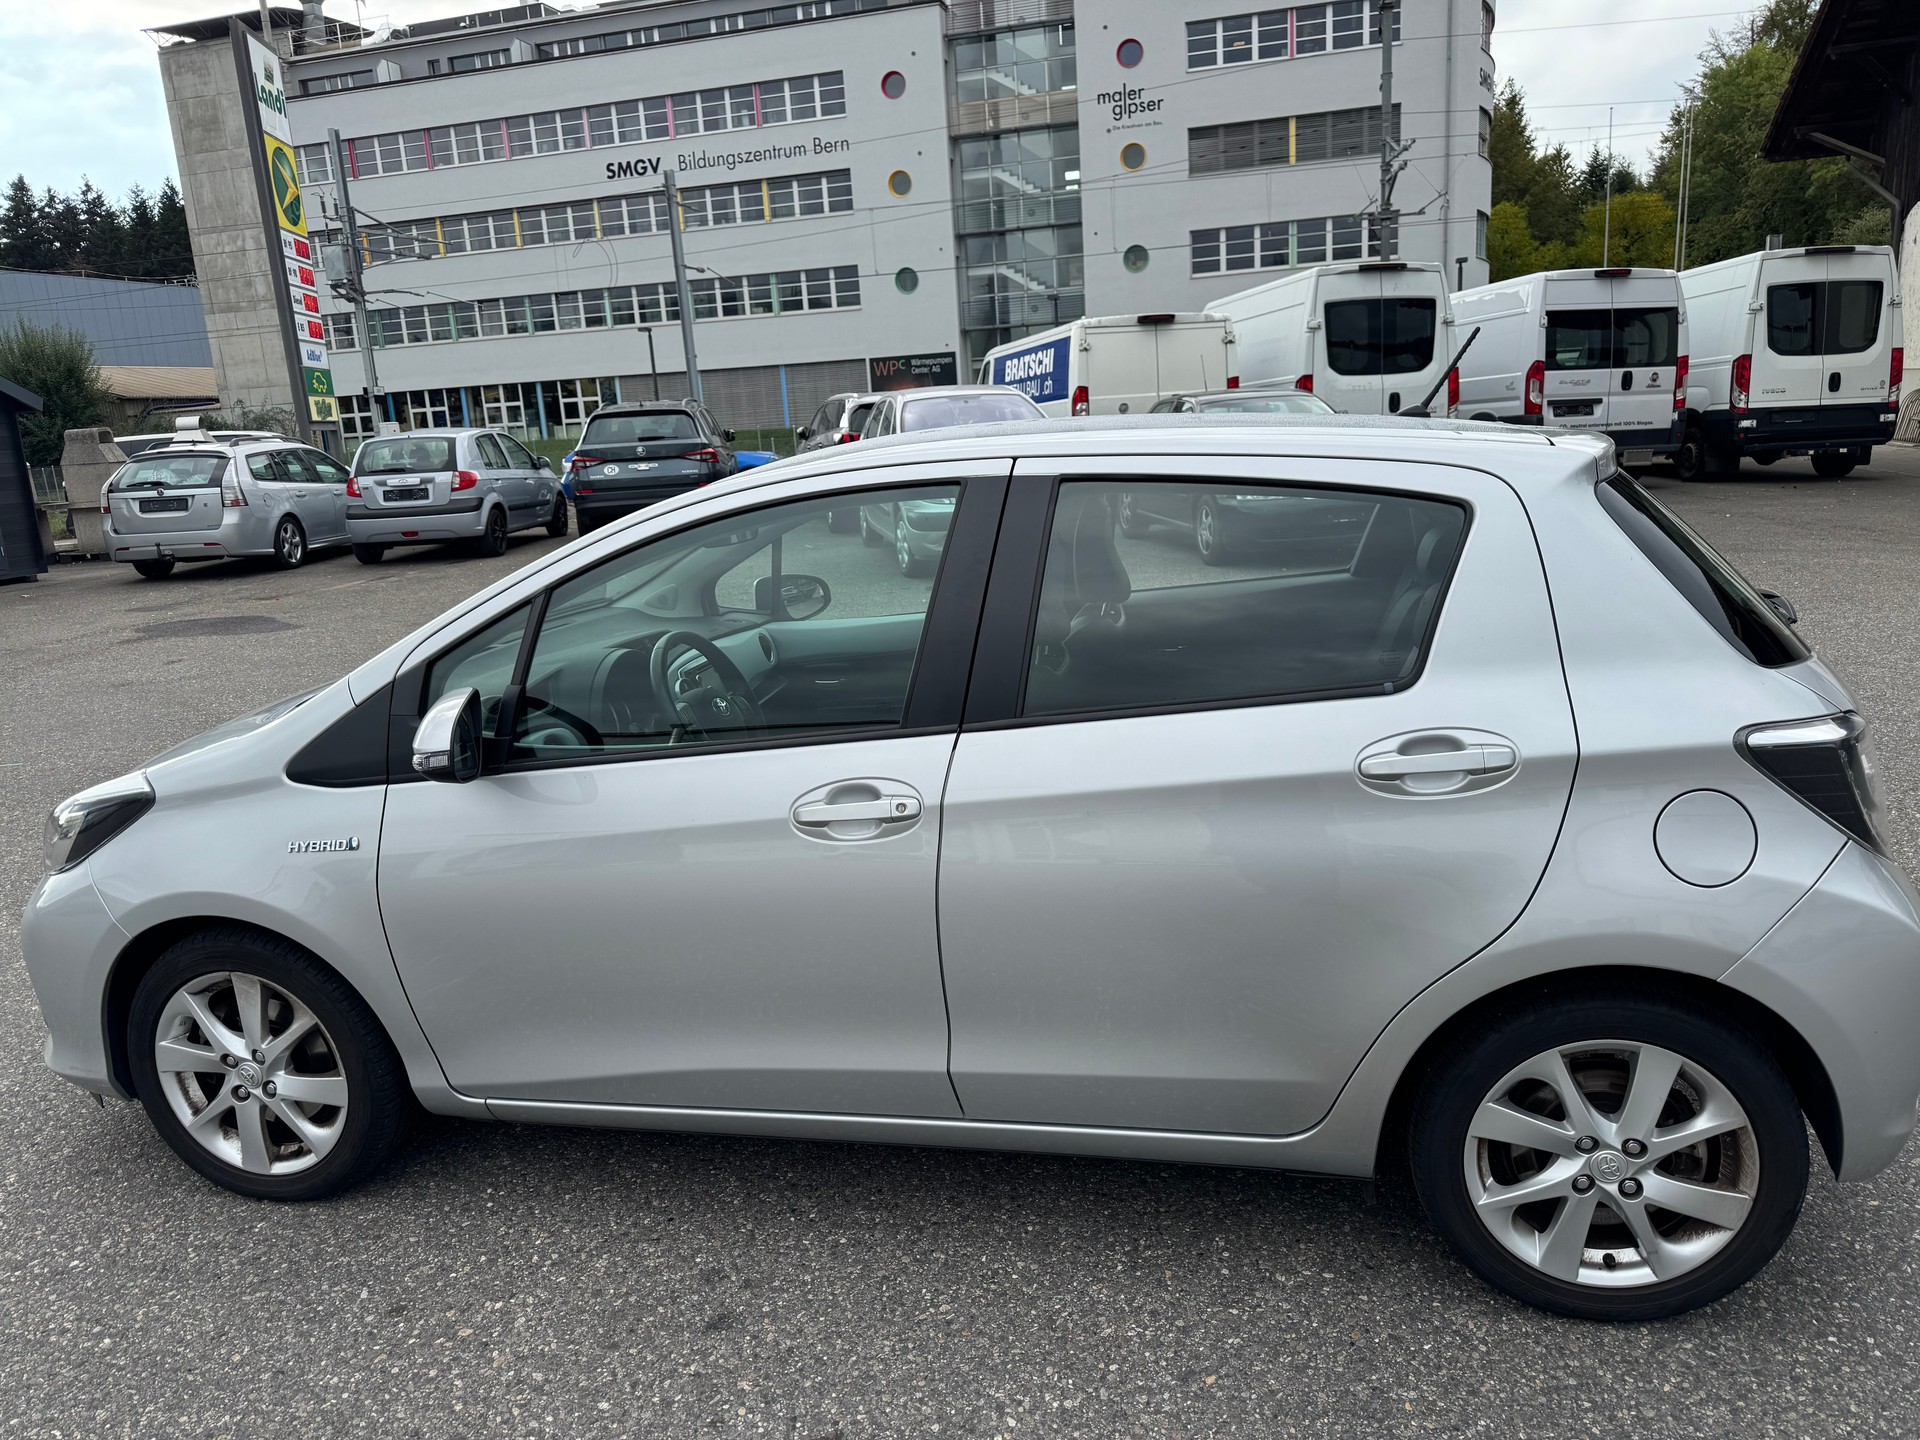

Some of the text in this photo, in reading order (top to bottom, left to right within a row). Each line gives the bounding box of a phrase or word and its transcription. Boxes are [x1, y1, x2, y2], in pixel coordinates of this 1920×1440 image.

[1097, 82, 1145, 105] maler
[606, 136, 850, 180] SMGV Bildungszentrum Bern
[1005, 348, 1055, 383] BRATSCHI
[288, 839, 347, 853] HYBRID
